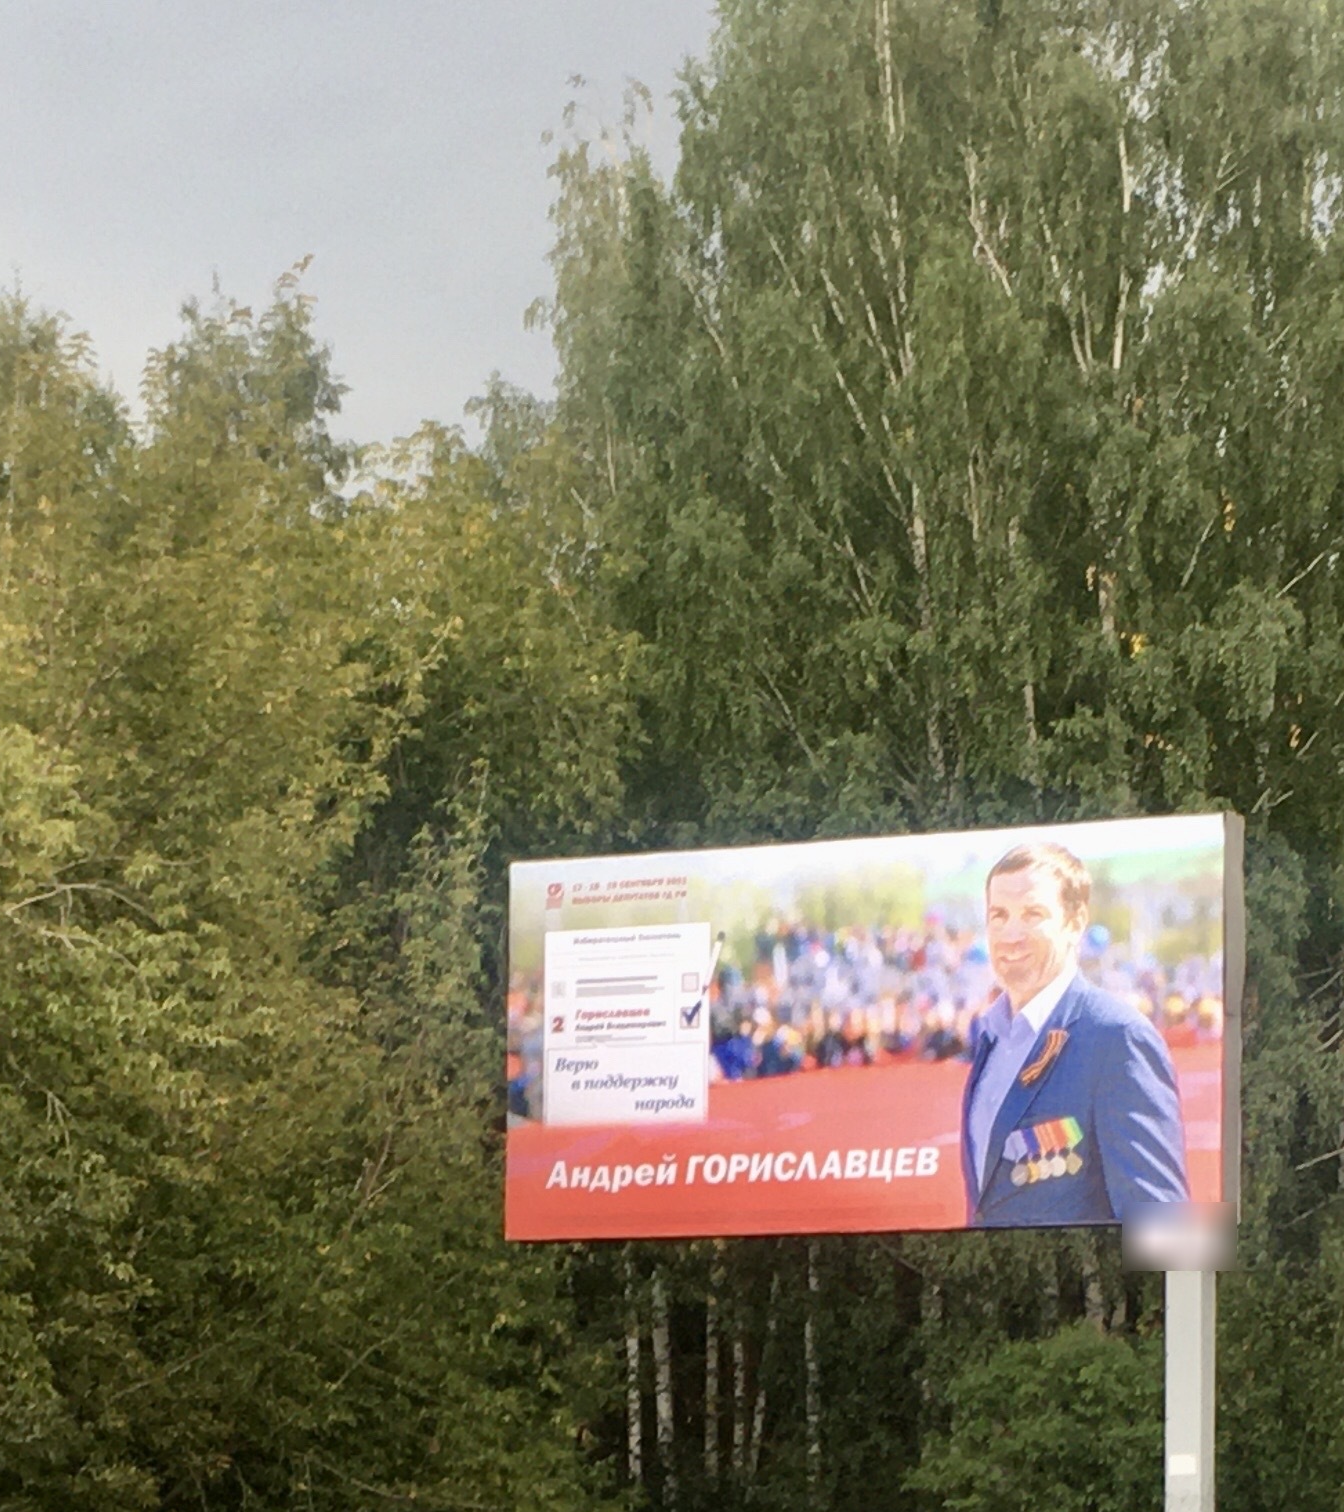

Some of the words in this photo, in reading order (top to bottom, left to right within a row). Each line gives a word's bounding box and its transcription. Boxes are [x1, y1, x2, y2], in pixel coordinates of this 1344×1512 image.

[552, 1016, 565, 1033] 2
[555, 1057, 599, 1075] Верю
[571, 1079, 581, 1090] в
[584, 1073, 679, 1091] поддержку
[635, 1094, 696, 1113] народа
[545, 1153, 677, 1193] Андрей
[685, 1146, 940, 1185] ГОРИСЛАВЦЕВ
